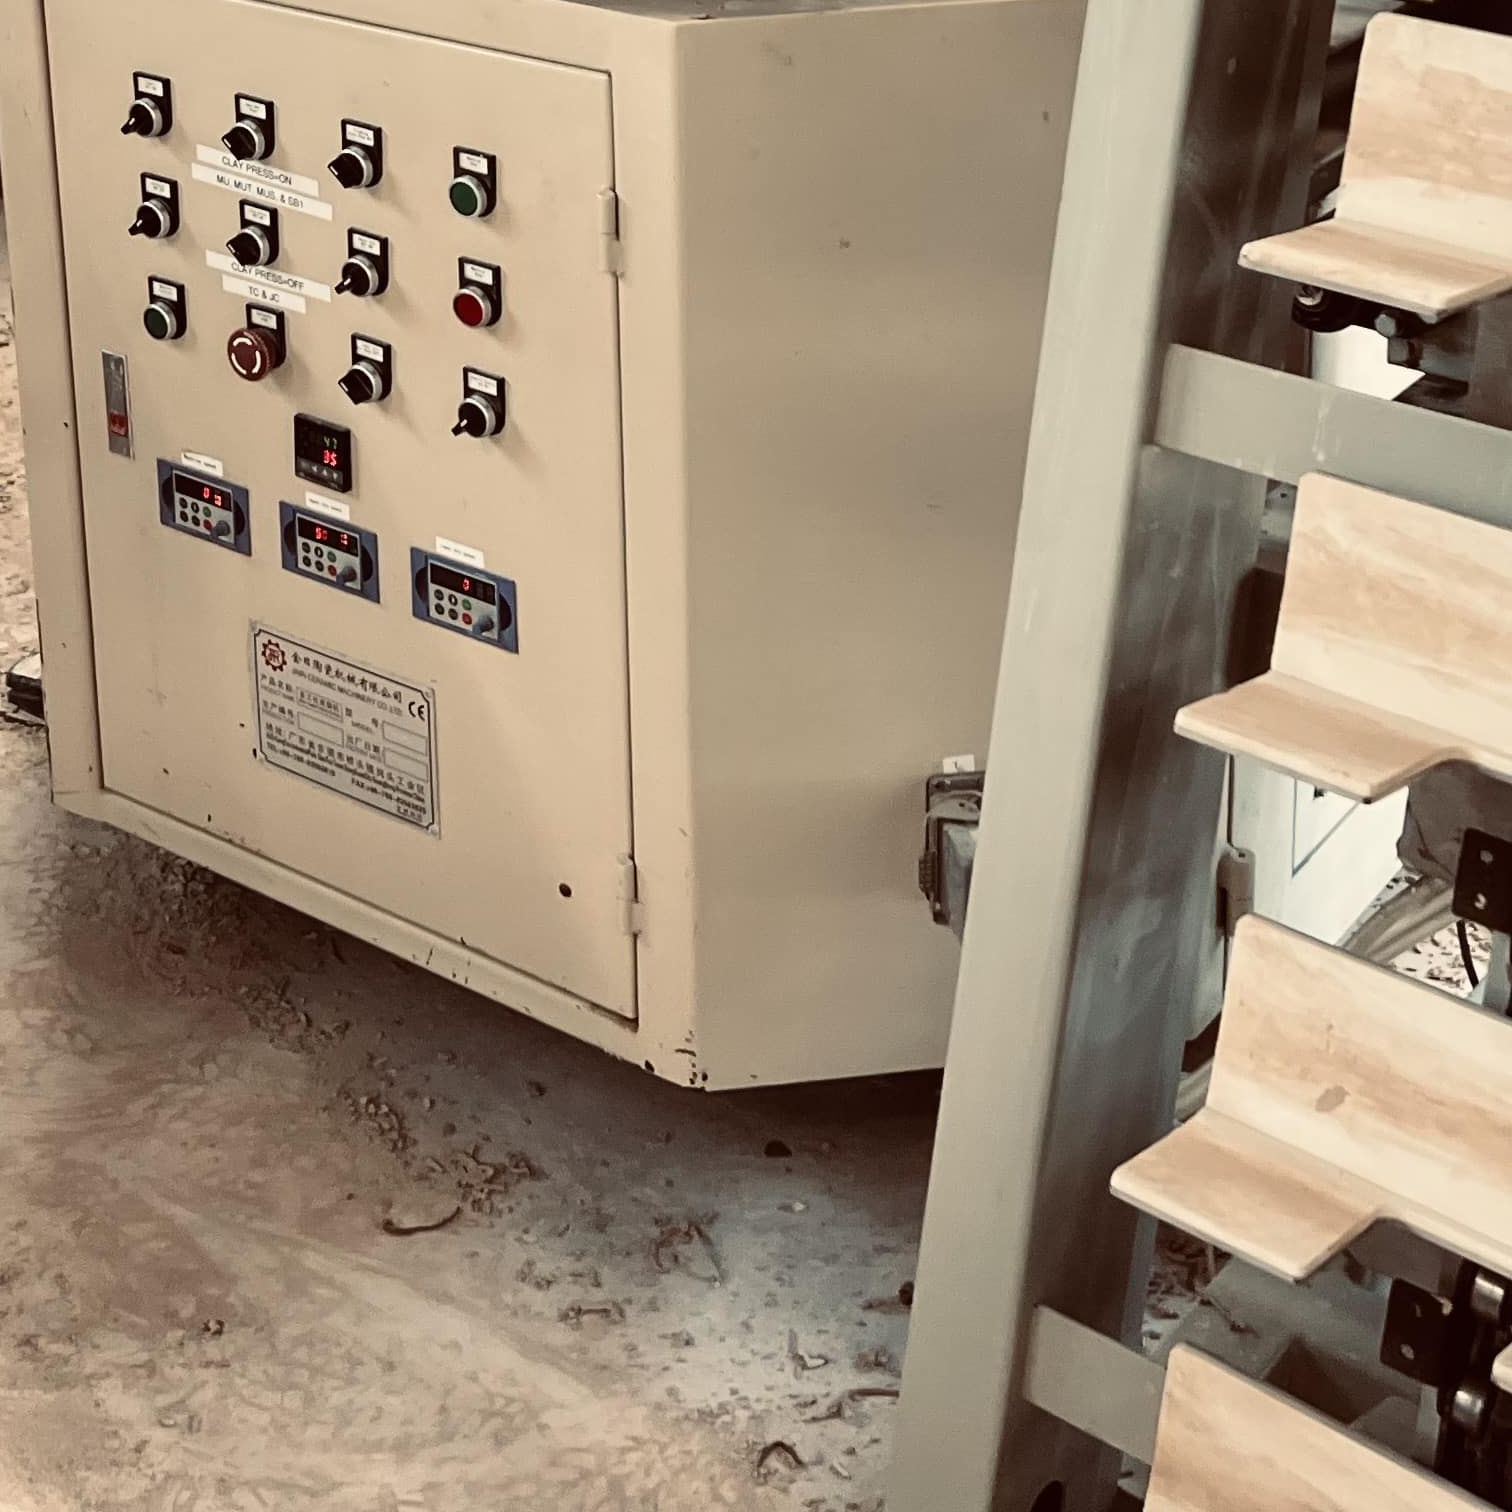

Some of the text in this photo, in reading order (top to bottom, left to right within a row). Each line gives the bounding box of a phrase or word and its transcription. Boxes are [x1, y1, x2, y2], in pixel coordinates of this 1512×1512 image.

[222, 155, 244, 170] CLAY
[280, 194, 286, 204] &
[287, 196, 304, 209] SB1
[231, 262, 253, 275] CLAY
[249, 286, 260, 297] TC
[261, 290, 268, 300] &
[408, 701, 426, 722] CE
